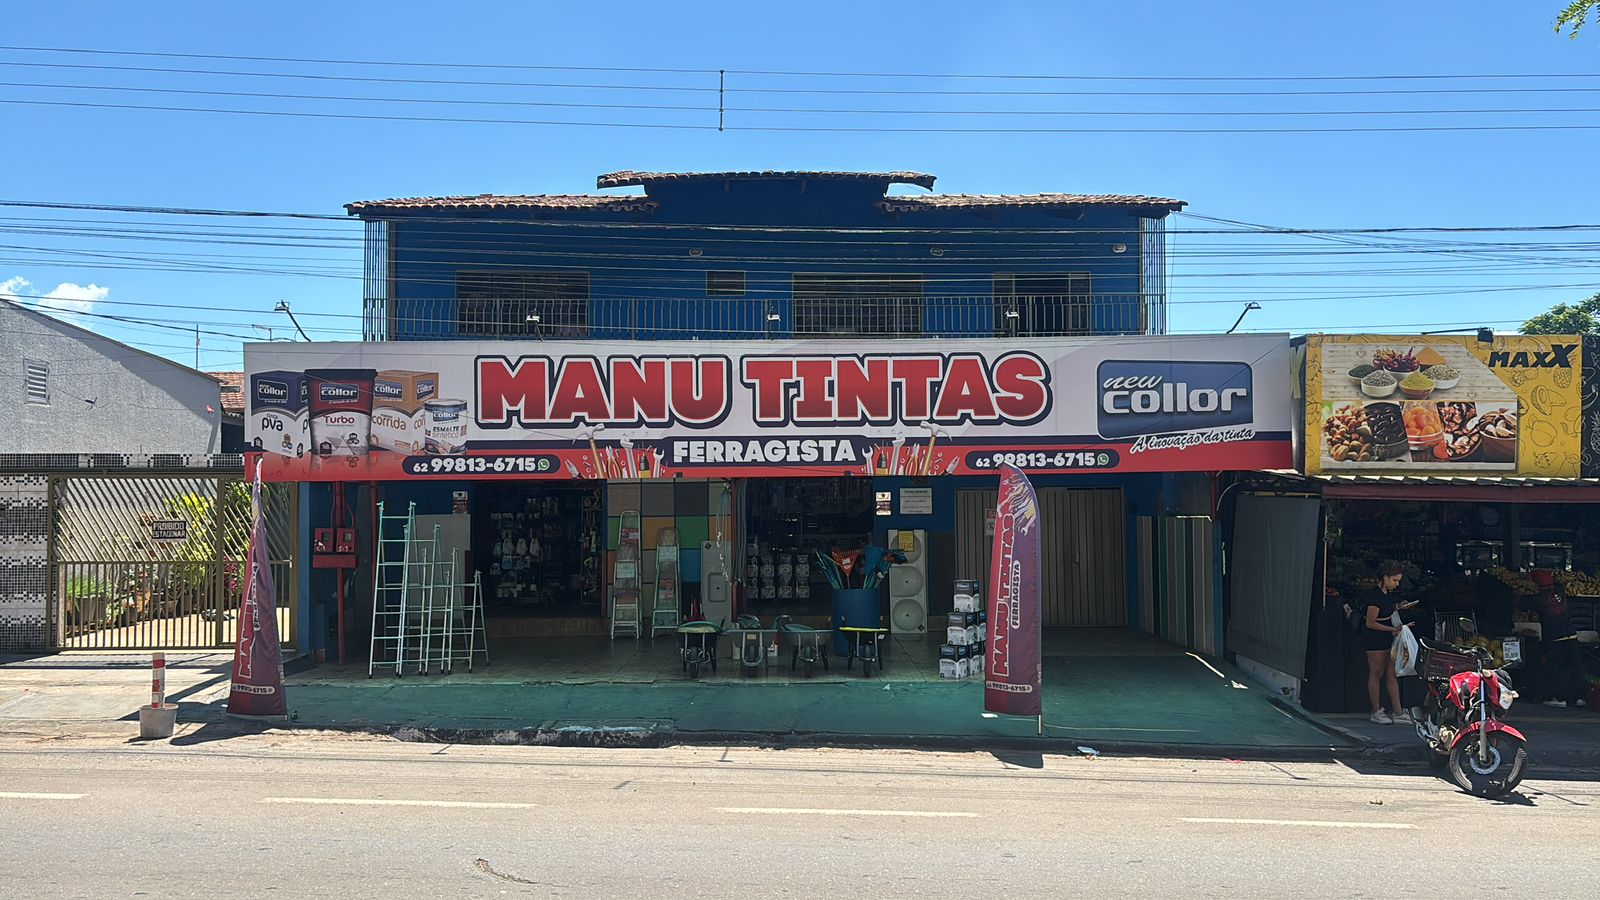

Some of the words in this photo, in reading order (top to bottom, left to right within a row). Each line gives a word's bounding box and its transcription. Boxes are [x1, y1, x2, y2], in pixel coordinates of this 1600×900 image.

[1489, 344, 1579, 368] MAXX
[476, 357, 729, 425] MANU
[742, 354, 1050, 422] TINTAS
[1103, 375, 1163, 389] new
[321, 388, 358, 396] collor
[1103, 382, 1247, 414] collor
[262, 417, 283, 431] pva
[324, 415, 355, 424] Turbo
[372, 415, 407, 430] corrida
[433, 425, 460, 433] ESMALTE
[1130, 436, 1146, 453] A
[1149, 433, 1201, 450] inovação
[1204, 431, 1223, 443] da
[1224, 428, 1255, 440] tinta
[673, 439, 856, 463] FERRAGISTA
[413, 462, 428, 473] 62
[431, 457, 536, 472] 99813-6715
[976, 458, 990, 467] 62
[992, 452, 1096, 467] 99813-6715
